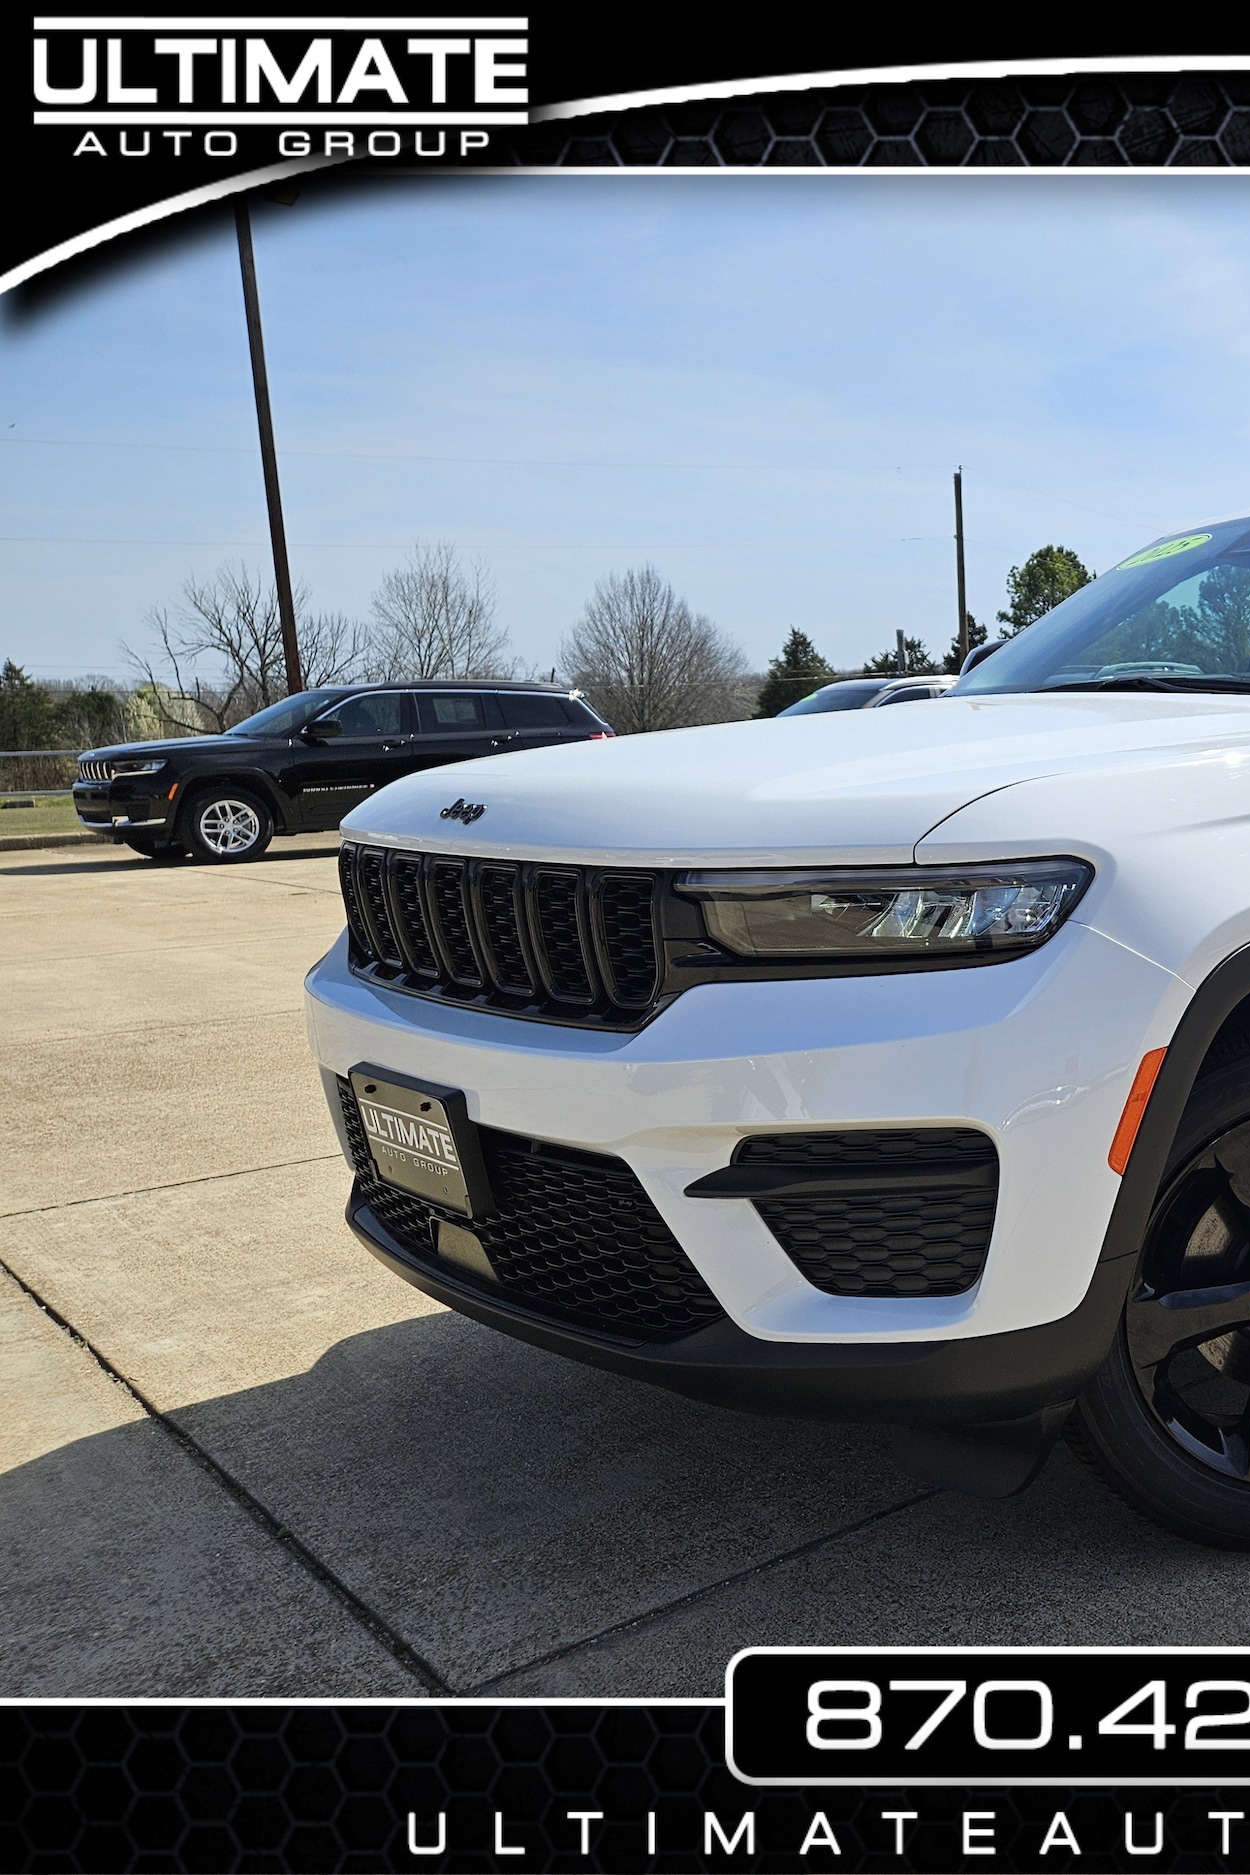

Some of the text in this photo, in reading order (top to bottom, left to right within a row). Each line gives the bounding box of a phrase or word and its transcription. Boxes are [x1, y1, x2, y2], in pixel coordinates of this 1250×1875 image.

[440, 798, 488, 826] Jeep
[360, 1105, 457, 1163] ULTIMATE
[381, 1145, 449, 1177] AUTO GROUP
